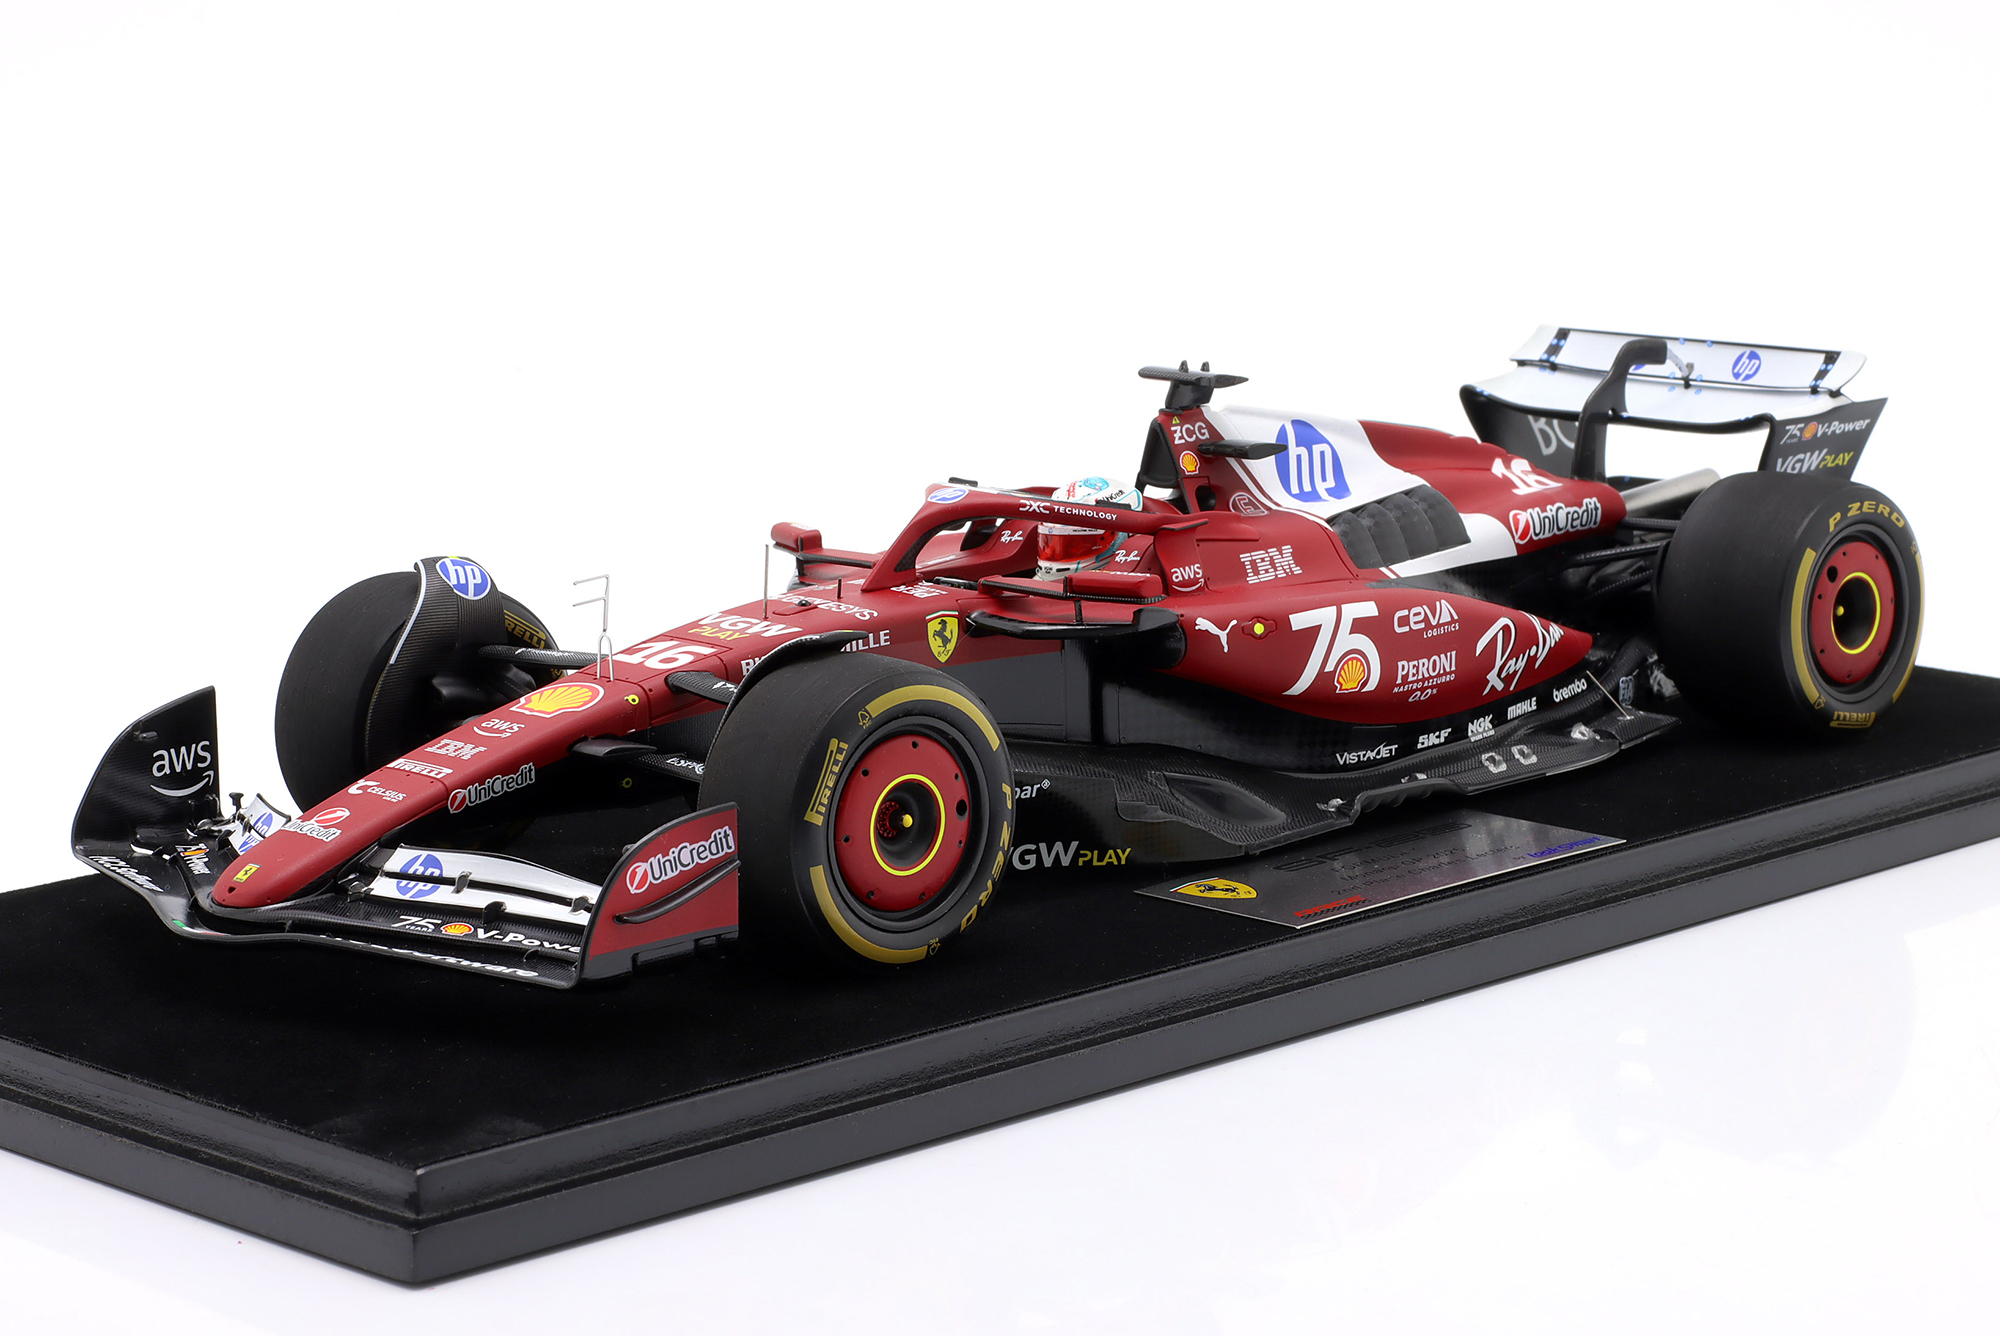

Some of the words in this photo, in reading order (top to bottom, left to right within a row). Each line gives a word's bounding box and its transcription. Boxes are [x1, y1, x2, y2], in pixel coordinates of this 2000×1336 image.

[1734, 350, 1761, 382] hp
[1817, 419, 1871, 438] V-Power
[1284, 419, 1340, 501] hp
[1776, 448, 1828, 474] VGW
[1819, 451, 1854, 469] PLAY
[1491, 458, 1563, 496] 16
[1019, 499, 1051, 514] DXC
[1053, 505, 1118, 521] TECHNOLOGY
[1530, 498, 1600, 538] UniCredit
[1829, 512, 1842, 533] P
[1847, 500, 1905, 529] ZERO
[1171, 563, 1203, 583] aws
[1240, 545, 1302, 584] IBM
[445, 558, 487, 600] hp
[503, 609, 547, 650] RELLI
[688, 626, 750, 642] PLAY
[698, 612, 803, 639] VGW
[1423, 622, 1460, 638] LOGISTICS
[612, 640, 714, 670] 16
[1282, 601, 1381, 696] 75
[1396, 650, 1457, 685] PERONI
[1393, 682, 1422, 693] NASTRO
[1423, 673, 1455, 688] AZZURRO
[1552, 678, 1588, 703] brembo
[1507, 696, 1537, 720] MAHLE
[1830, 711, 1876, 729] PIRELLI
[481, 717, 526, 735] aws
[1416, 727, 1452, 750] SKF
[1467, 713, 1493, 736] NGK
[151, 740, 212, 778] aws
[385, 758, 454, 780] PIRELLI
[366, 785, 407, 801] CELSIUS
[466, 763, 535, 807] UniCredit
[803, 737, 849, 827] PIRELLI
[282, 818, 343, 842] UniCredit
[650, 827, 735, 882] UniCredit
[1008, 840, 1080, 871] GW
[1078, 847, 1132, 867] PLAY
[391, 915, 443, 933] 75
[476, 927, 582, 954] V-Powe
